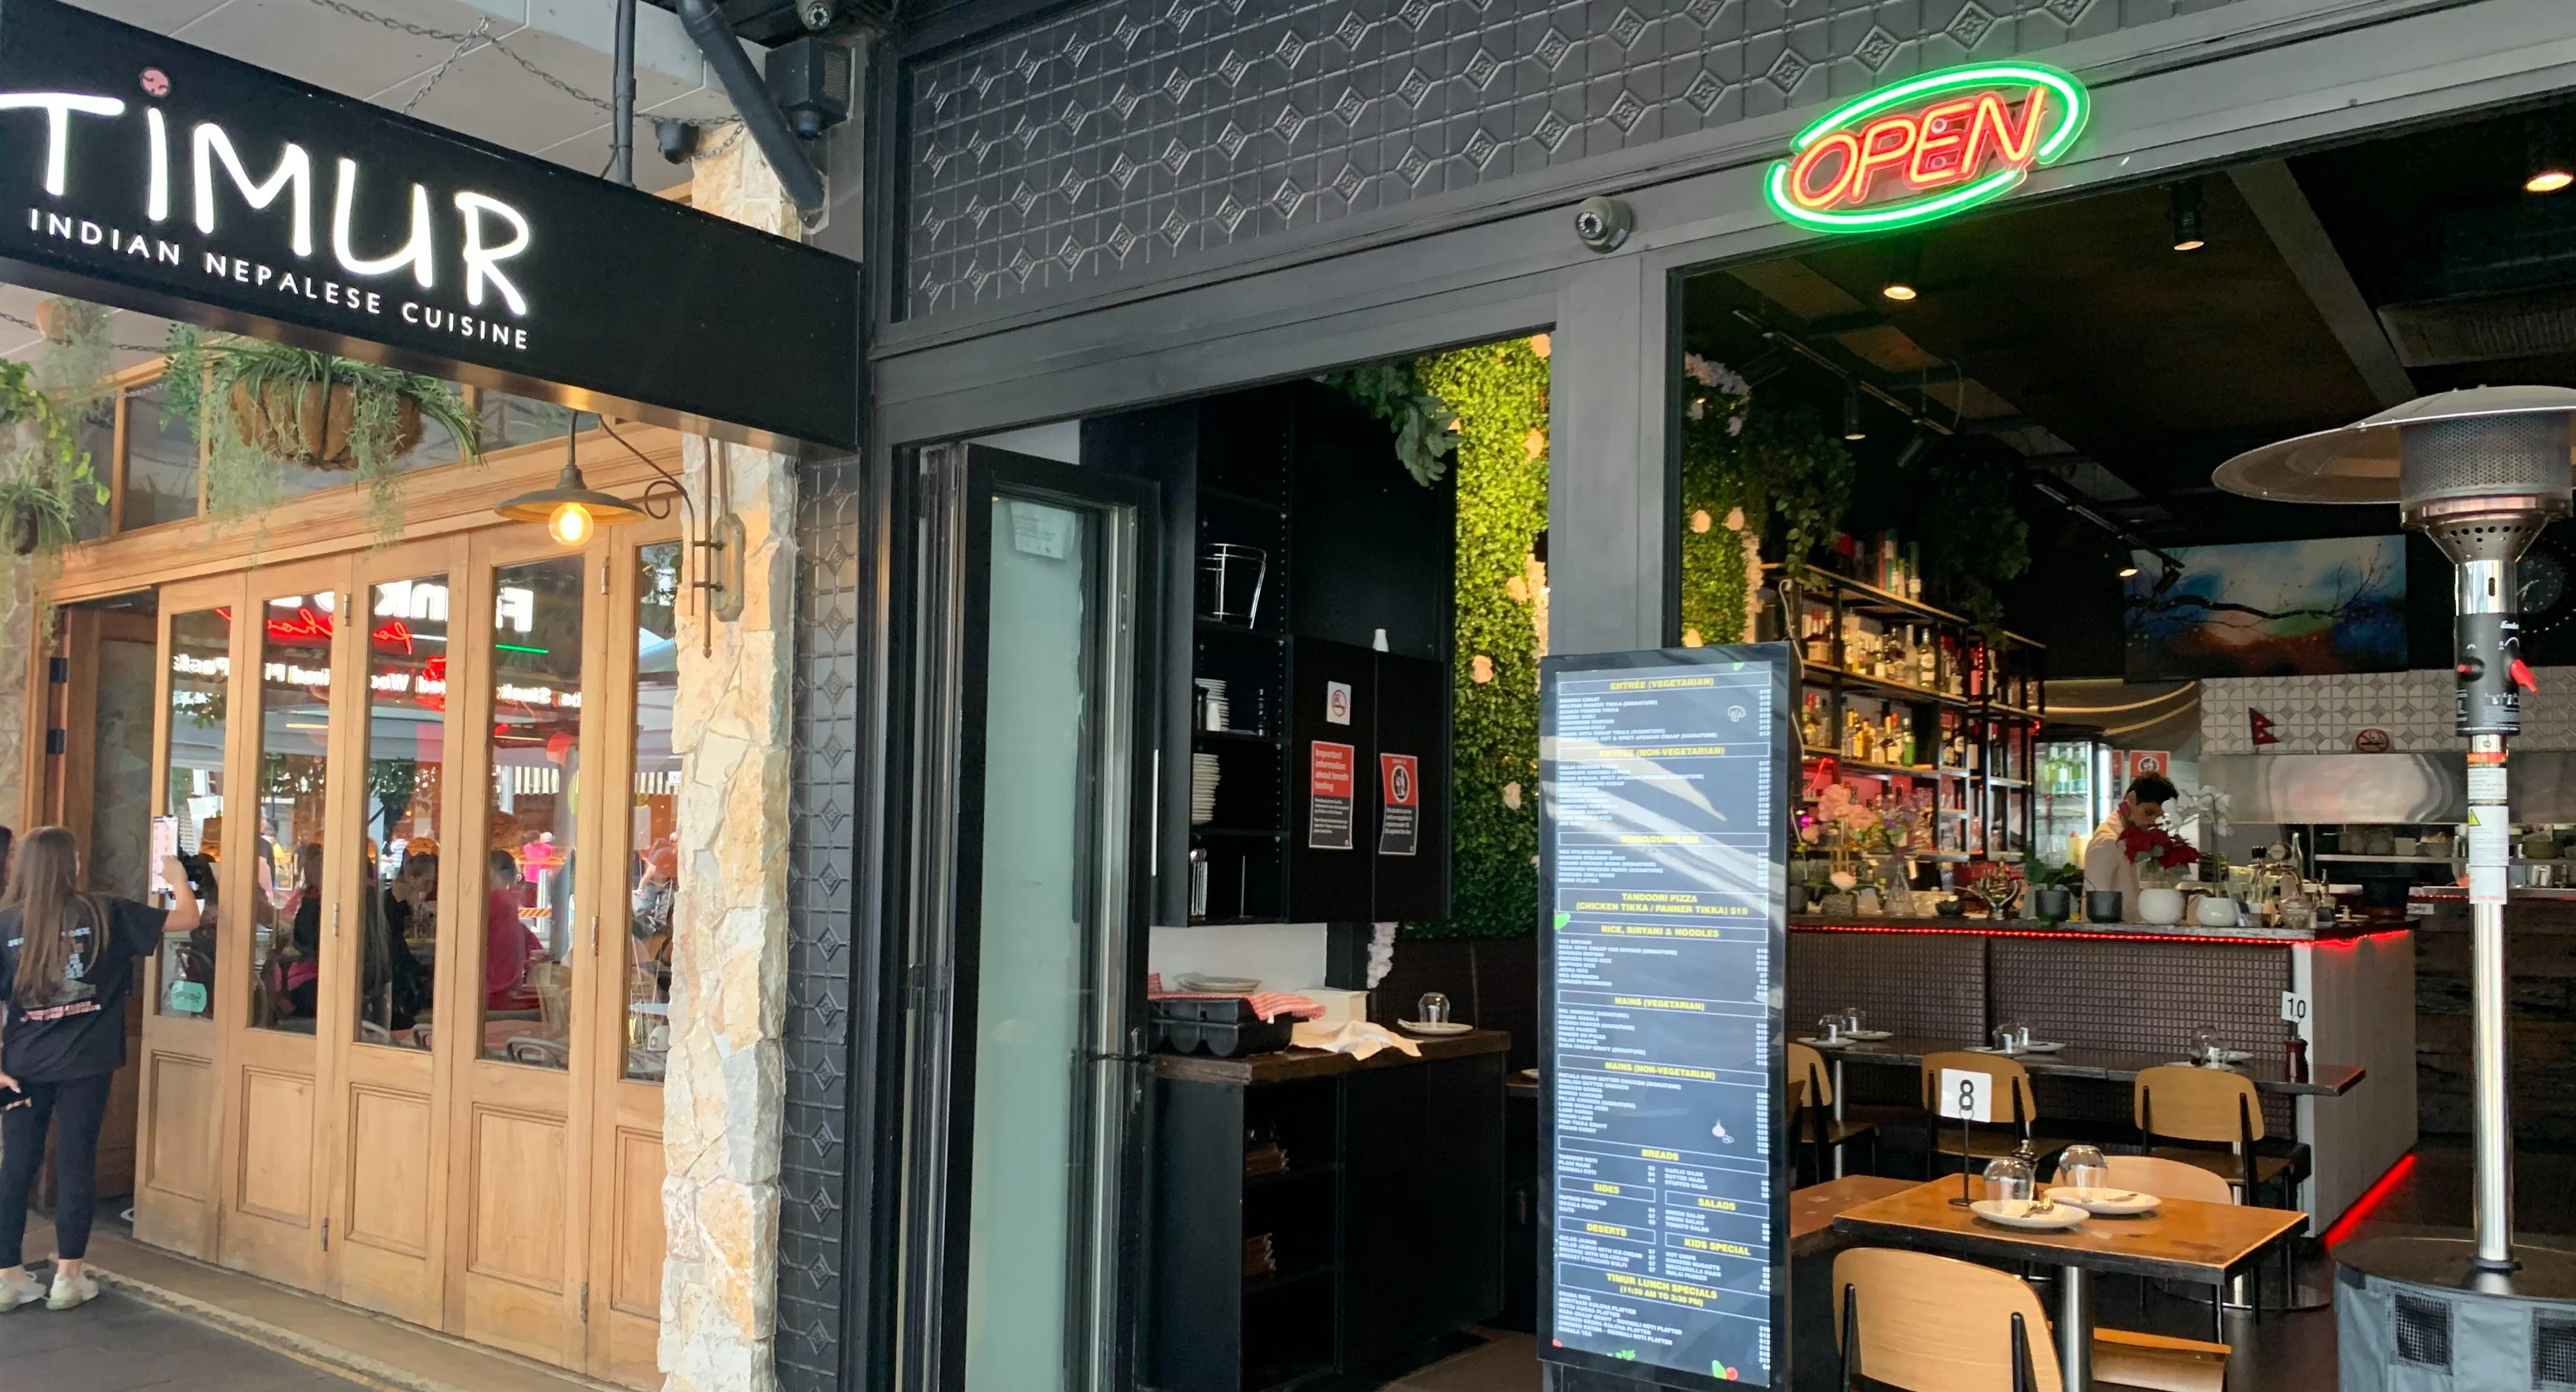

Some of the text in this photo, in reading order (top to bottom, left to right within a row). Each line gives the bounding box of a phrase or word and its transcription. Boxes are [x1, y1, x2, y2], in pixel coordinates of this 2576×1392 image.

[1792, 86, 2046, 207] OPEN
[0, 66, 529, 316] TIMUR
[28, 208, 528, 349] INDIAN NEPALESE CUISINE
[1648, 677, 1713, 688] (VEGETARIAN)
[1636, 747, 1724, 756] (NON-VEGETARIAN)
[1621, 892, 1667, 901] TANDOORI
[1575, 901, 1618, 910] (CHICKEN
[1694, 905, 1727, 914] TIKKA)
[1601, 925, 1624, 934] RICE,
[1626, 926, 1663, 935] BIRYANI
[1675, 928, 1719, 937] NOODLES
[1614, 997, 1705, 1010] MAINS (VEGETARIAN)
[2287, 997, 2306, 1018] 10
[1604, 1062, 1715, 1079] MAINS (NON-VEGETARIAN)
[1959, 1080, 1974, 1110] 8
[1641, 1149, 1679, 1160] BREADS
[1593, 1183, 1620, 1193] SIDES
[1698, 1198, 1735, 1211] SALADS
[1684, 1238, 1751, 1255] KIDS SPECIAL
[1606, 1273, 1717, 1299] TIMUR LUNCH SPECIALS
[1619, 1285, 1703, 1306] (11:30 AM TO 3:30 PM)
